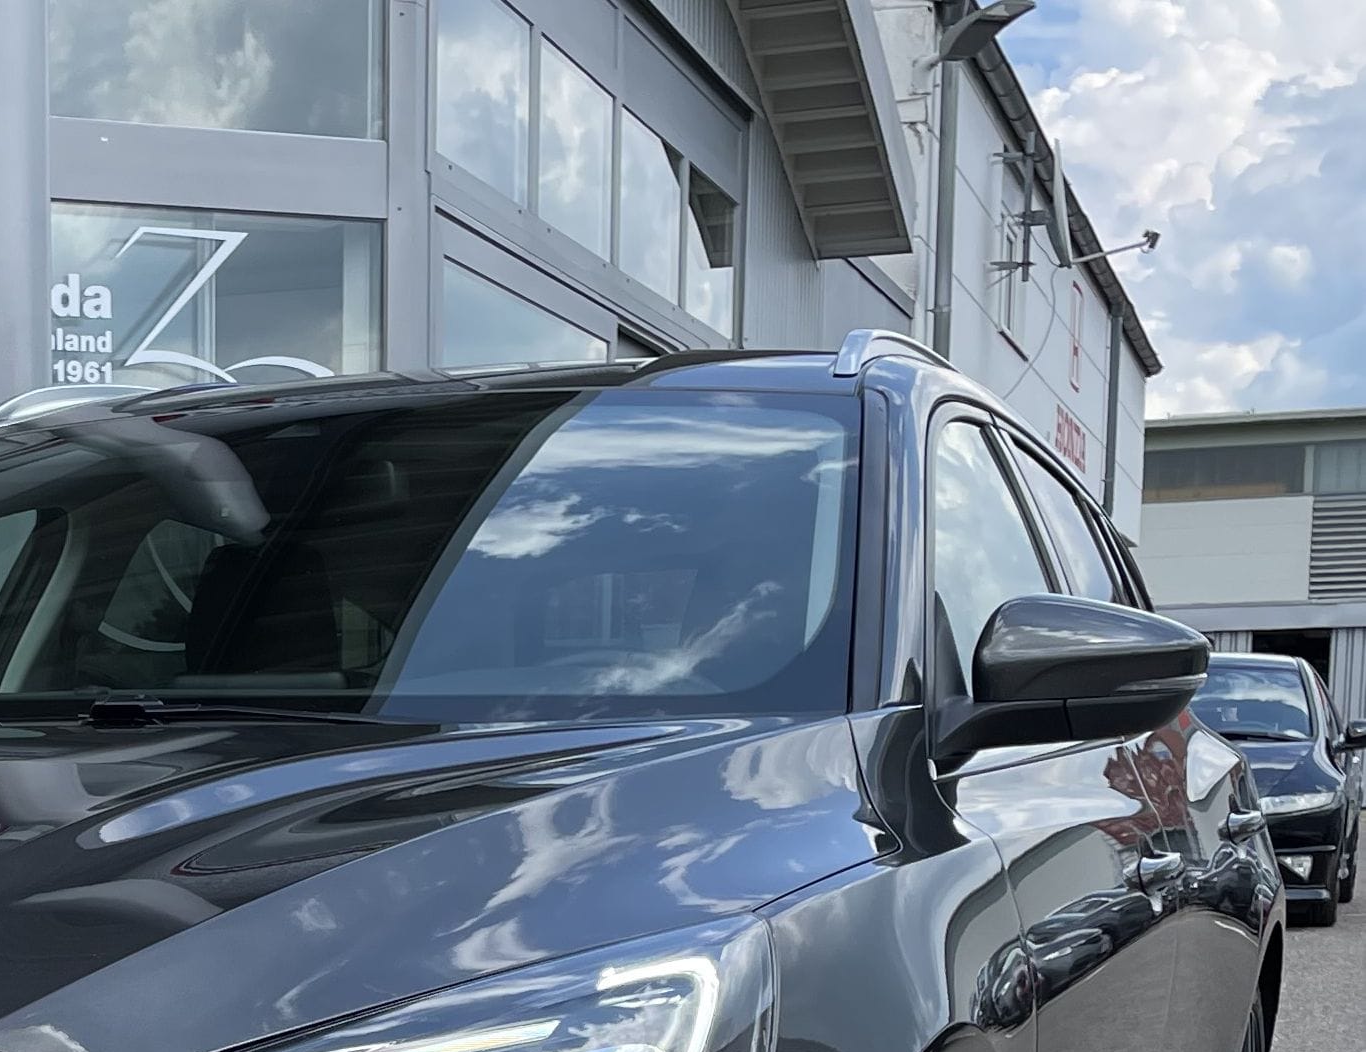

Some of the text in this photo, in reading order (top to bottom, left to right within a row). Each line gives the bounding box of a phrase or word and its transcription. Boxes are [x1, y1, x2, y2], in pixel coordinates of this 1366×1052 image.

[50, 273, 112, 319] da
[51, 328, 113, 353] land
[53, 359, 113, 384] 1961
